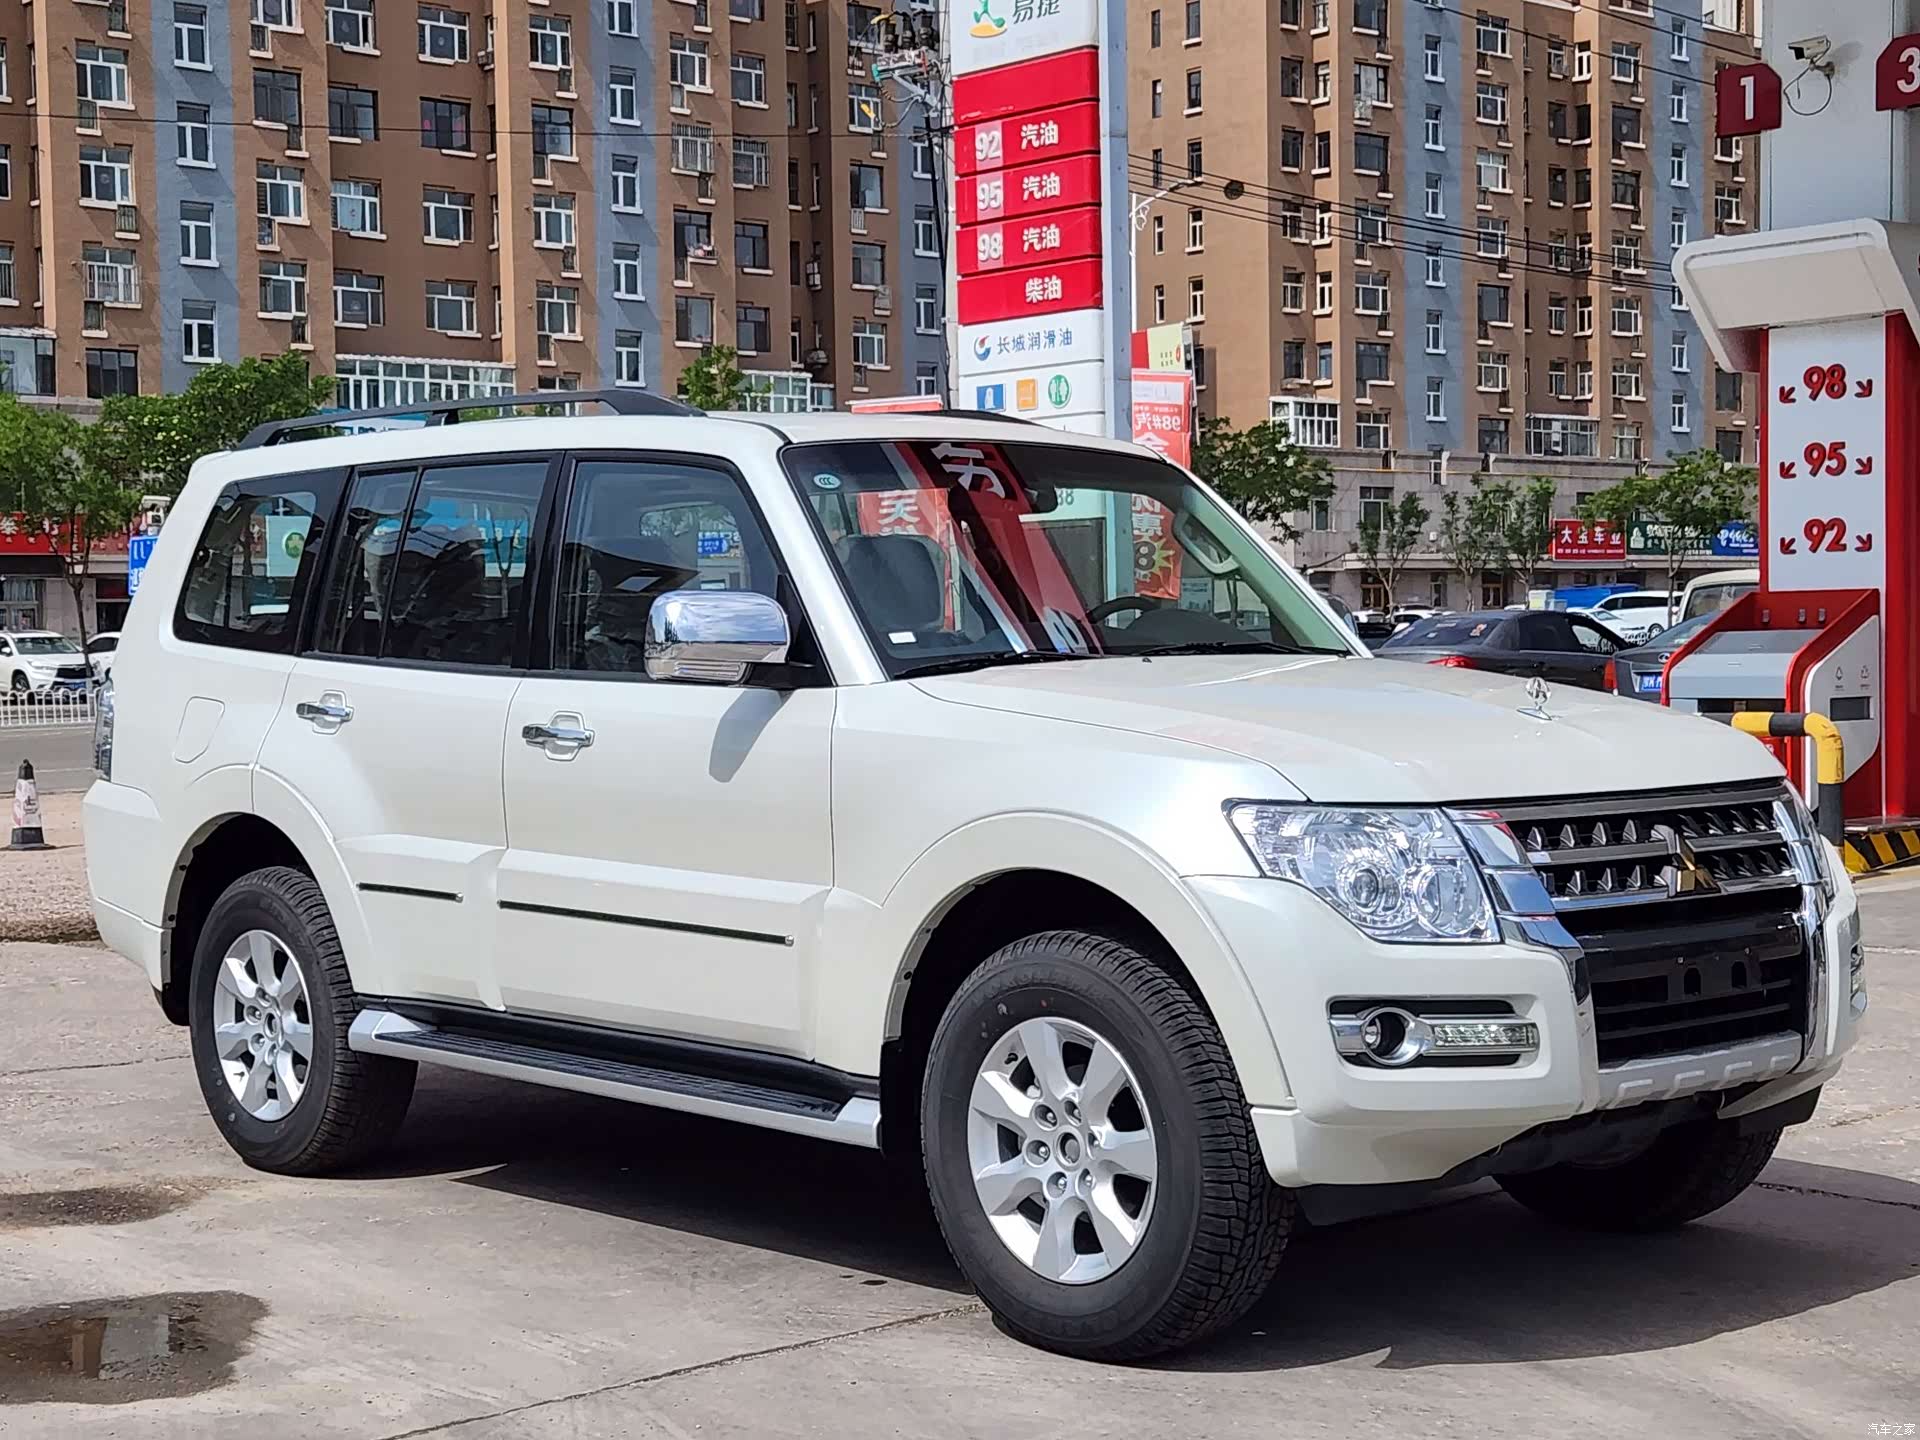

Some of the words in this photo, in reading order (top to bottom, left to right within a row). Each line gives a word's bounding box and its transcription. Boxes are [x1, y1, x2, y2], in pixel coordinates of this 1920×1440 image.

[1896, 47, 1920, 93] 3
[1740, 75, 1755, 121] 1
[975, 130, 1001, 161] 92
[1020, 120, 1059, 150] 汽油
[977, 181, 1001, 211] 95
[1022, 172, 1061, 201] 汽油
[977, 232, 1002, 262] 98
[1022, 223, 1061, 253] 汽油
[1025, 275, 1062, 304] 柴油
[997, 327, 1073, 355] 长城润滑油
[1803, 363, 1847, 401] 98
[1803, 441, 1847, 477] 95
[1803, 517, 1847, 554] 92
